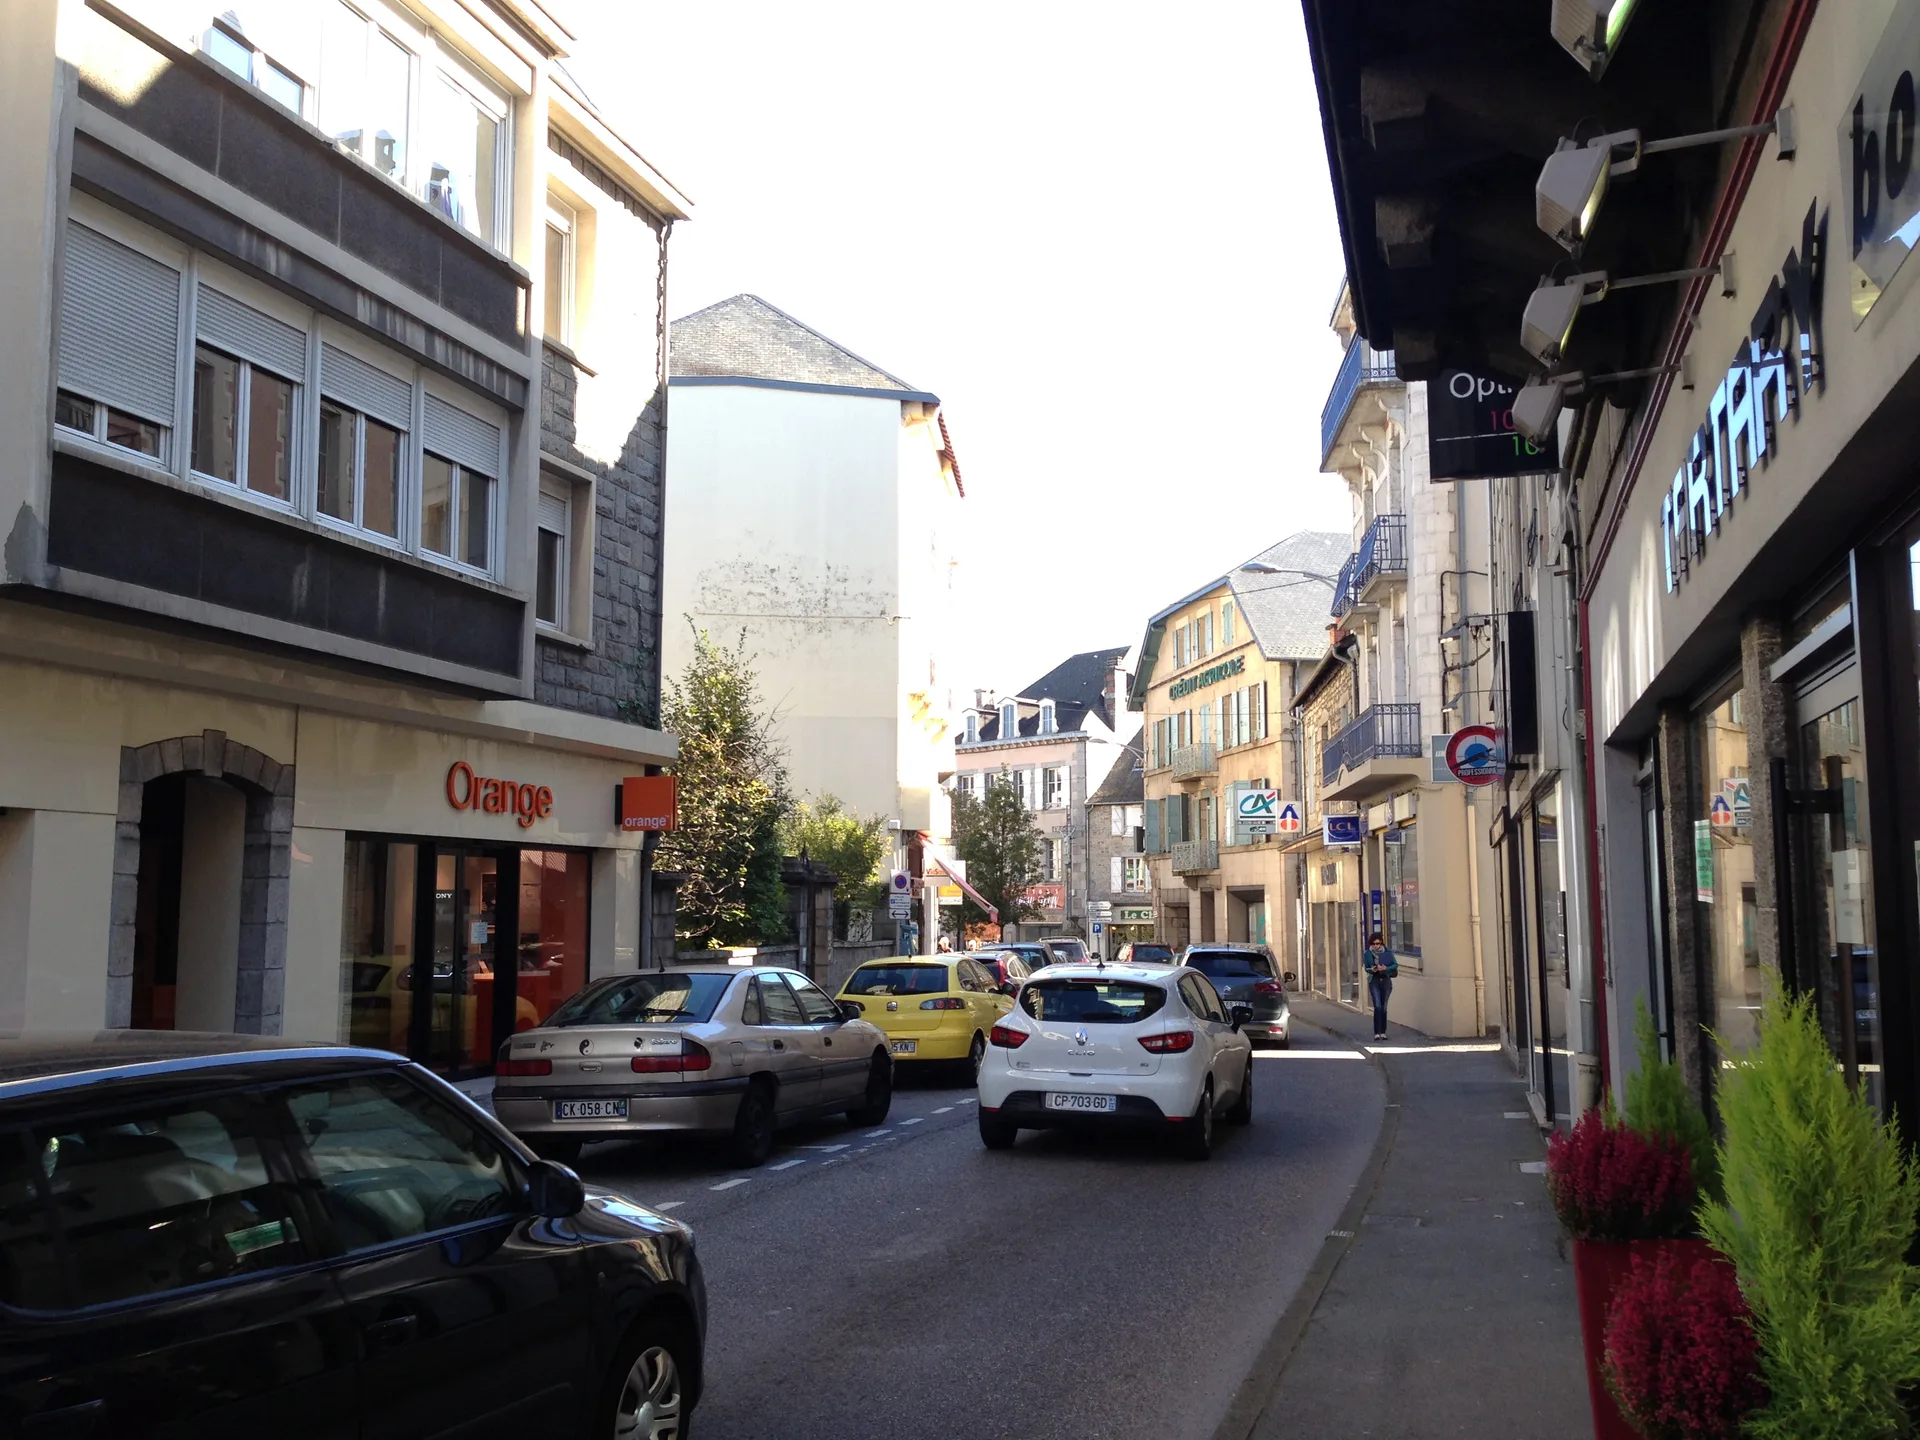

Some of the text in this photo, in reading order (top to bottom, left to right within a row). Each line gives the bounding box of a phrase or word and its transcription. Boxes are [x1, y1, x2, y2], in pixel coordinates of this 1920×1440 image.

[1199, 655, 1245, 689] AGRICOLE
[447, 761, 553, 828] Orange
[624, 817, 667, 829] orange
[1329, 821, 1355, 832] LCL
[1124, 910, 1137, 919] Le
